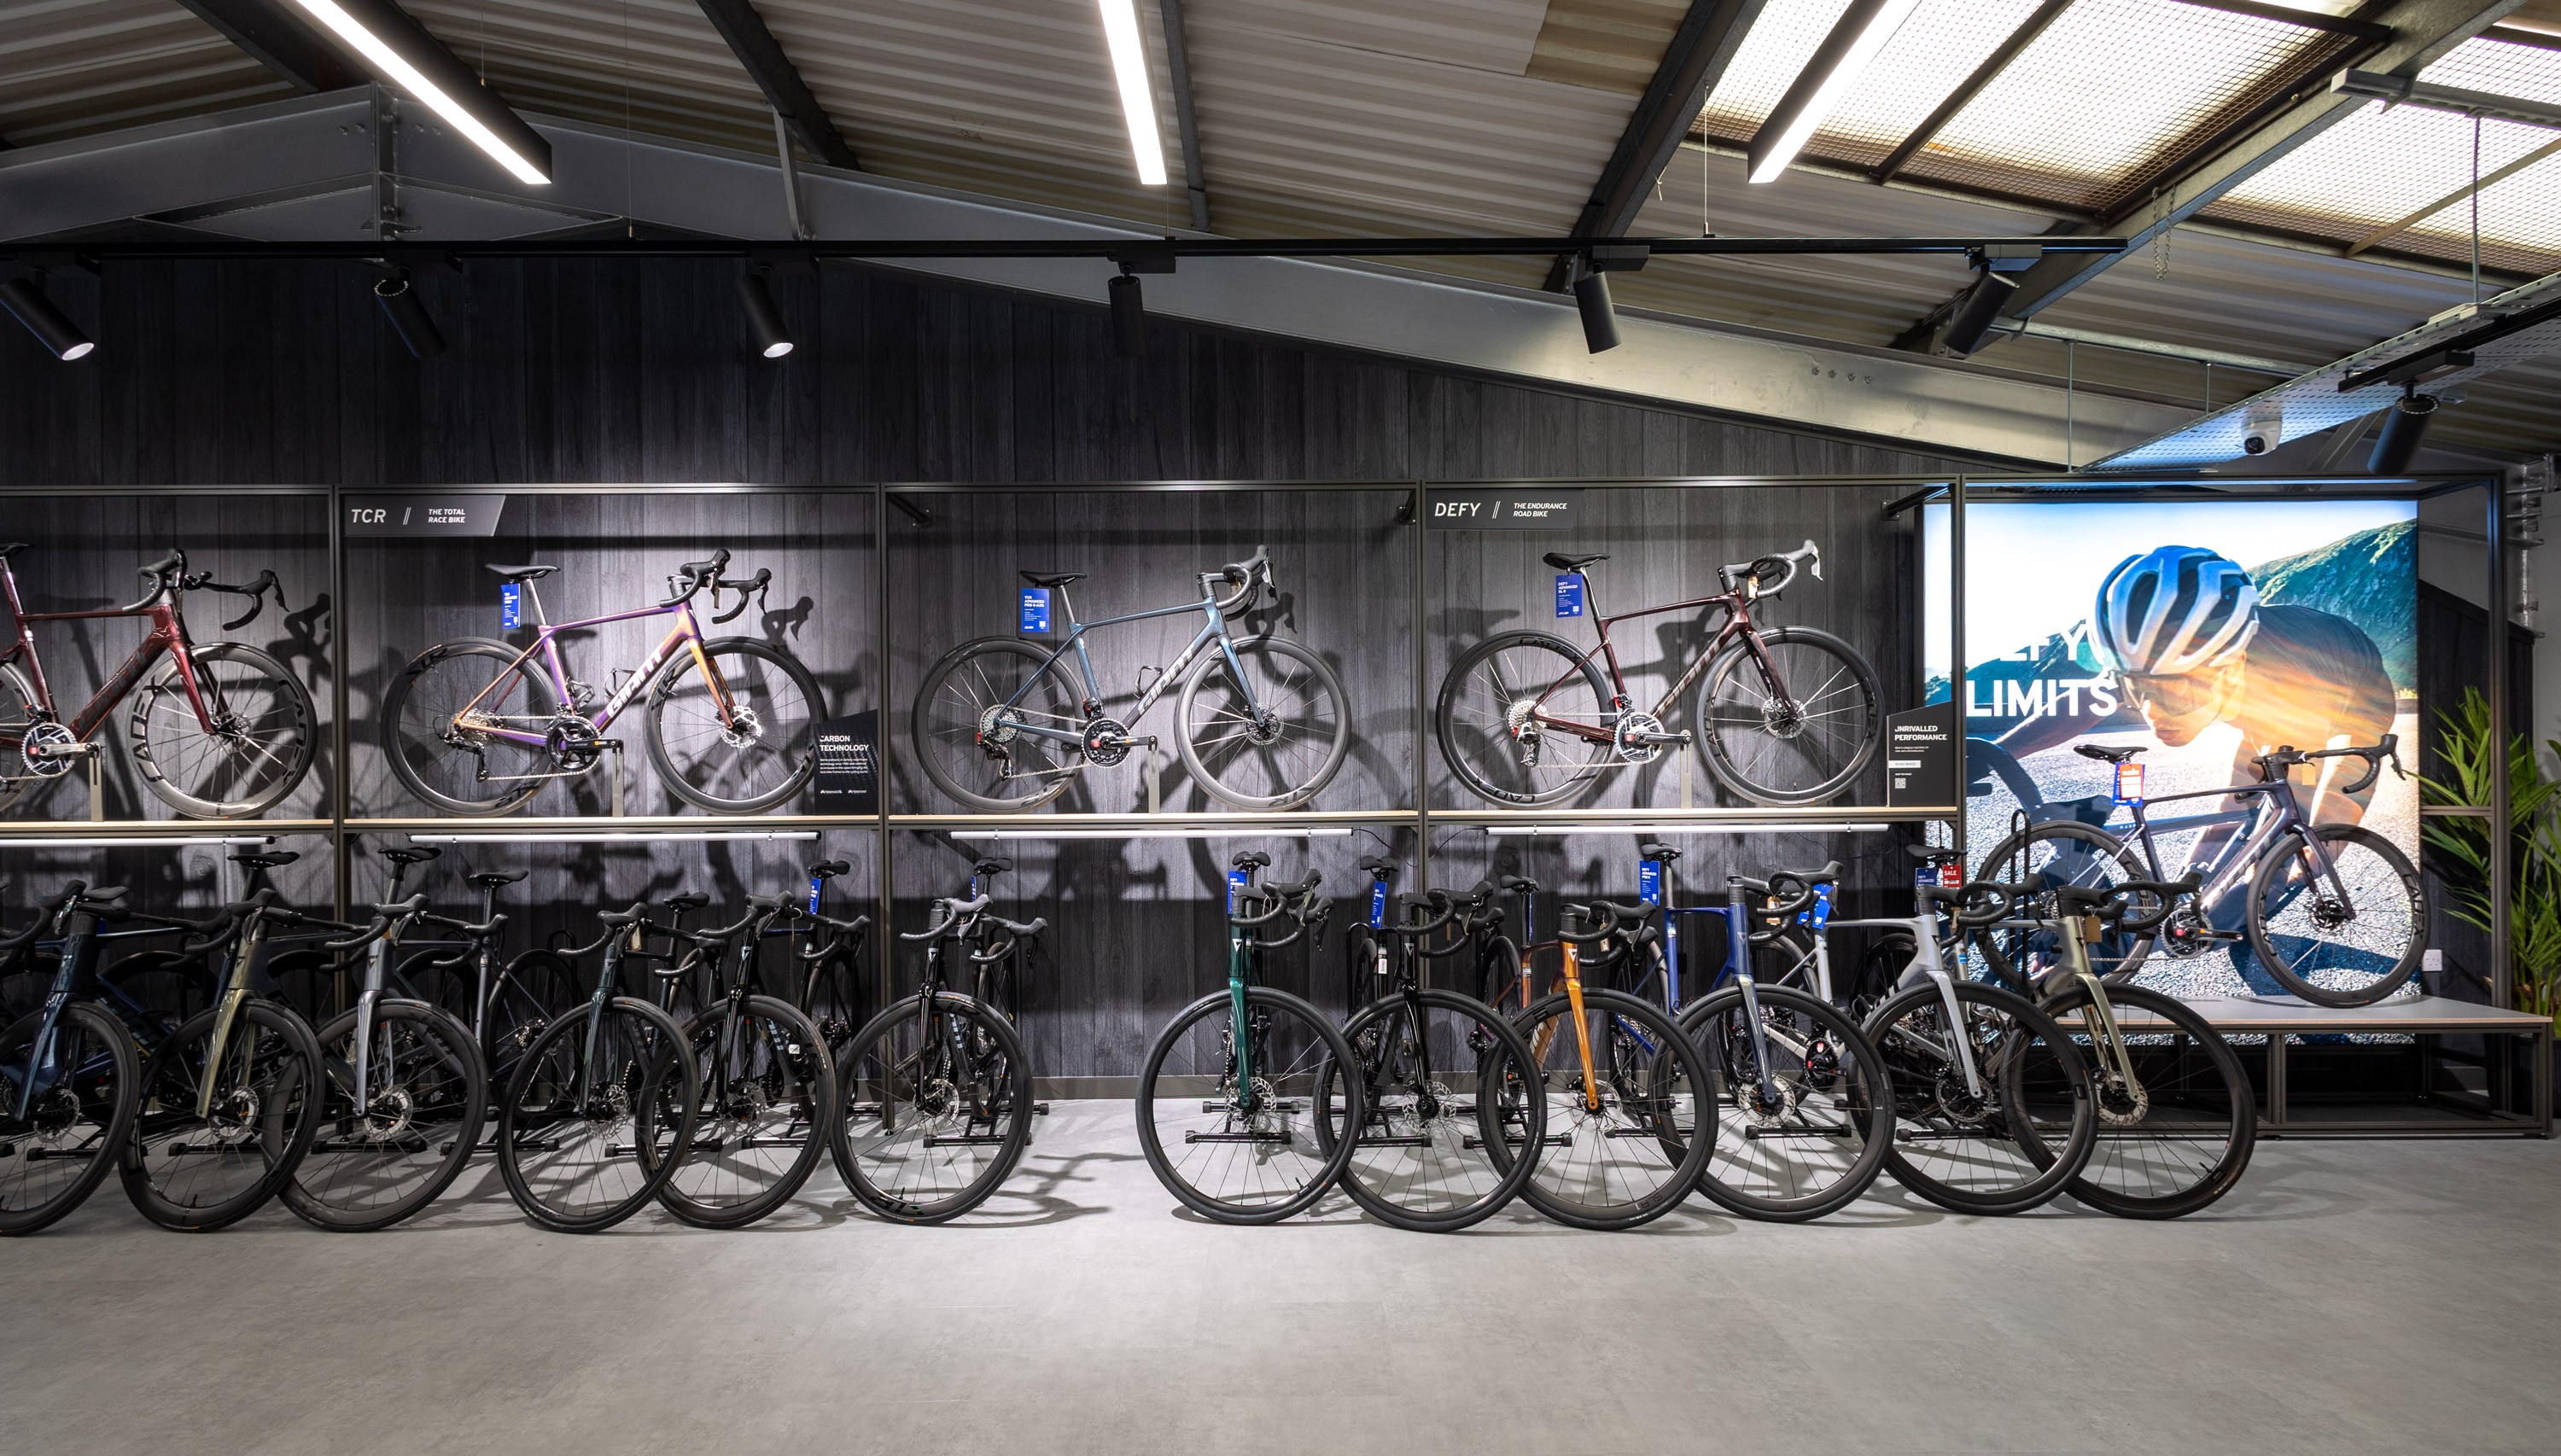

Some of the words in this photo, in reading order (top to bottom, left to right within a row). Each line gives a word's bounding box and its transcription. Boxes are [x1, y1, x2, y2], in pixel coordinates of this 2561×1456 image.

[351, 509, 387, 523] TCR
[1434, 503, 1481, 517] DEFY
[605, 641, 663, 719] GIANT
[1138, 641, 1194, 715] GIANT
[1965, 678, 2119, 717] LIMITS
[133, 674, 163, 783] CADEX
[2403, 873, 2424, 940] CADEX
